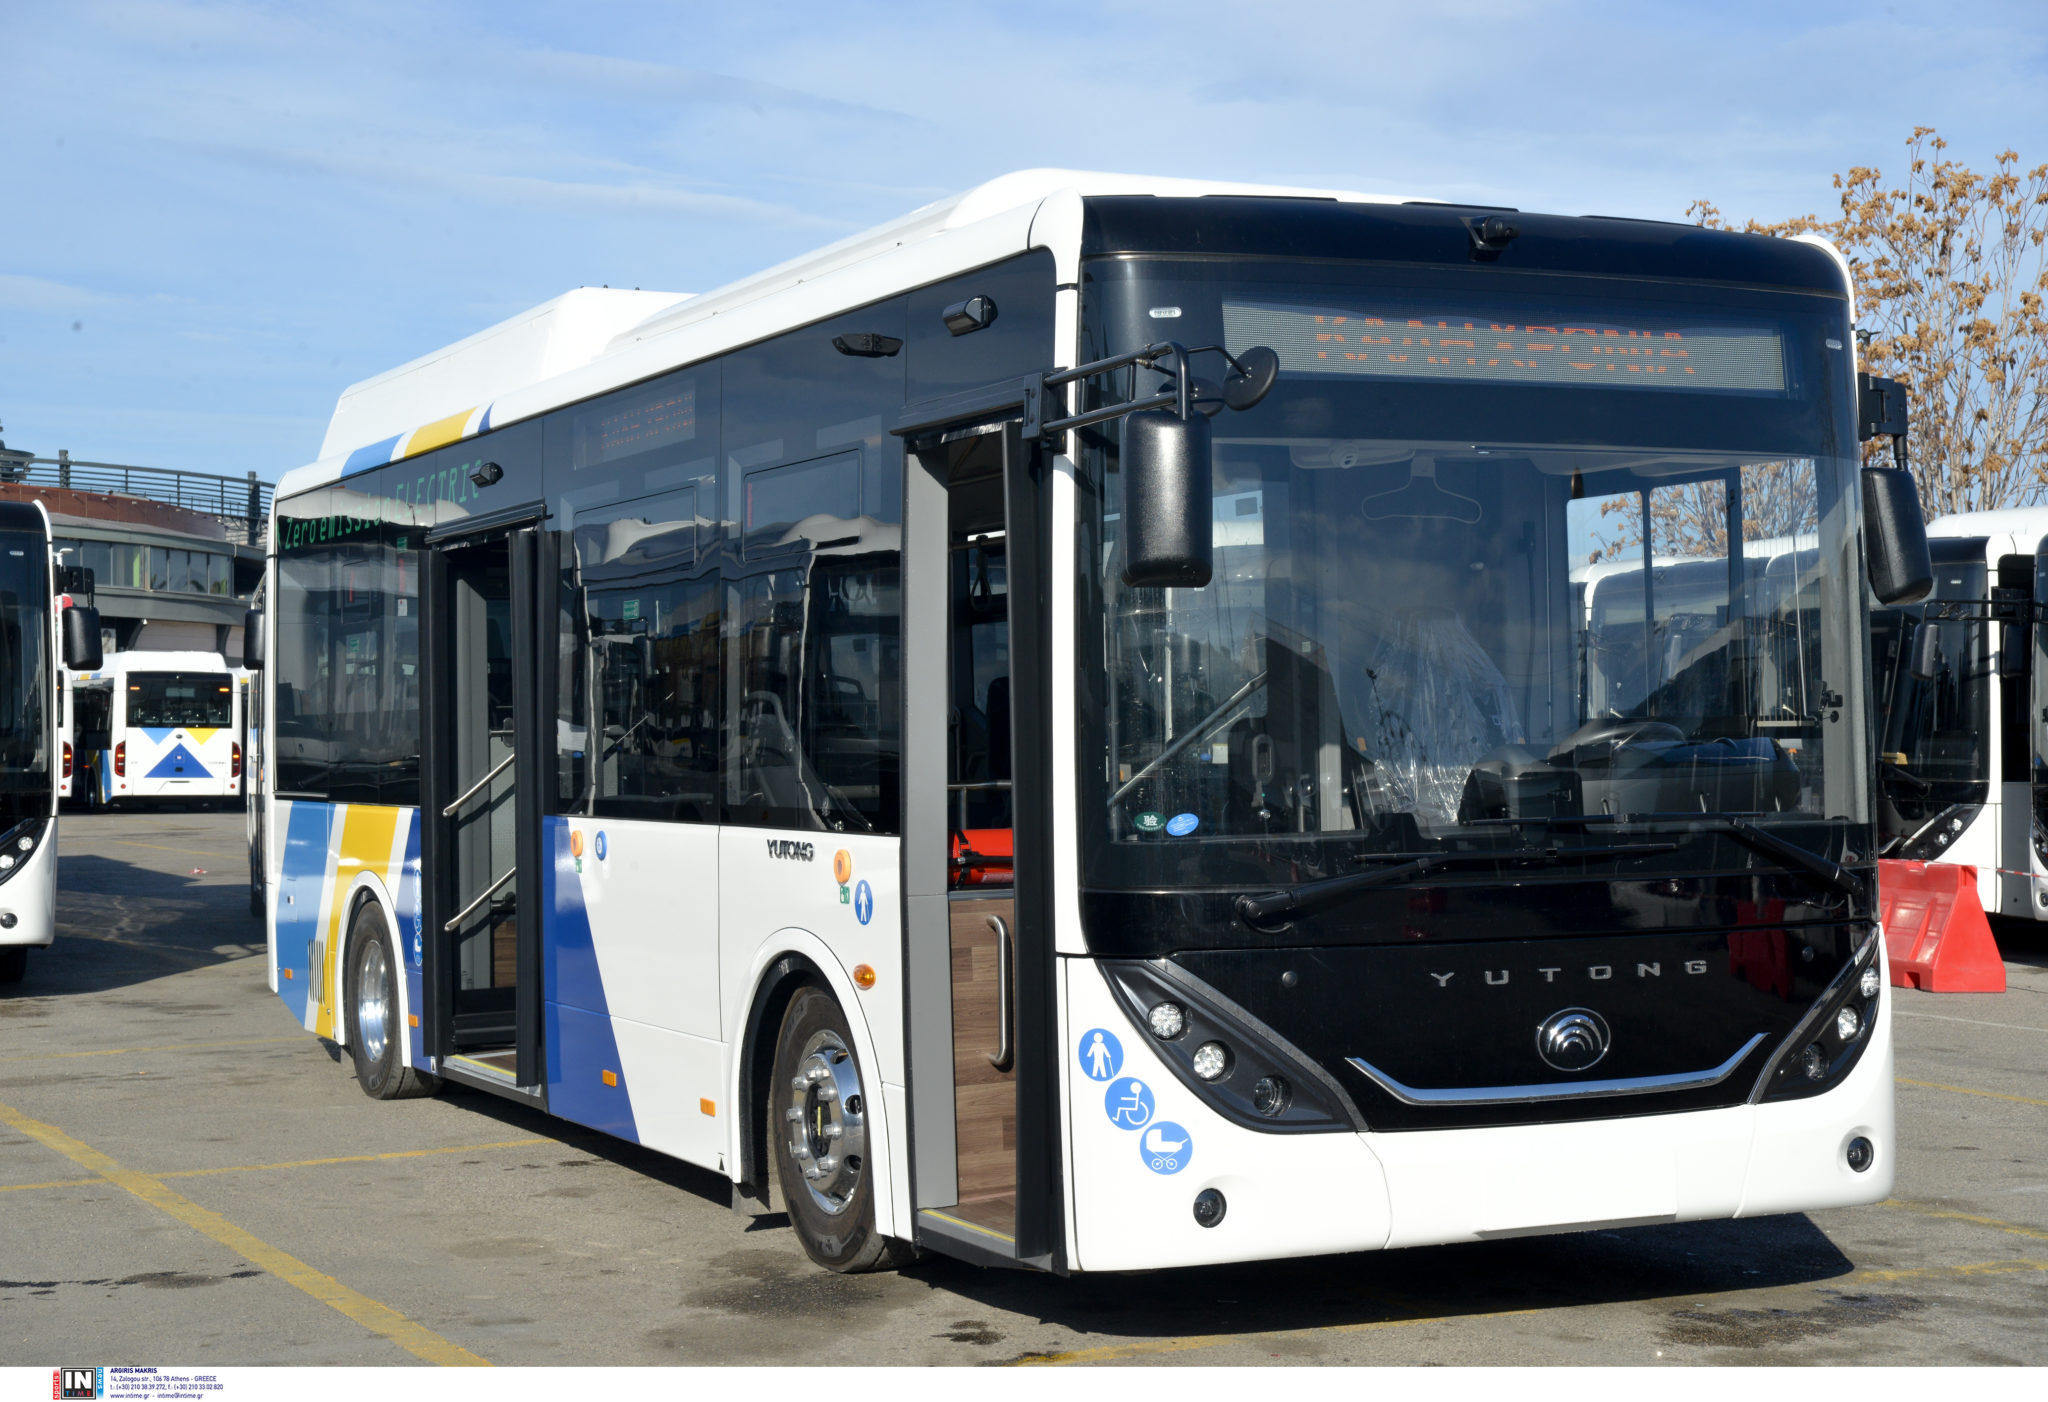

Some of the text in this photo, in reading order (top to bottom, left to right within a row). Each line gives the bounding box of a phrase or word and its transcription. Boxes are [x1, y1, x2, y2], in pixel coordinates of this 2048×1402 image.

[284, 518, 316, 550] Zero
[766, 839, 814, 862] YUTONG
[1430, 959, 1708, 987] YUTONG
